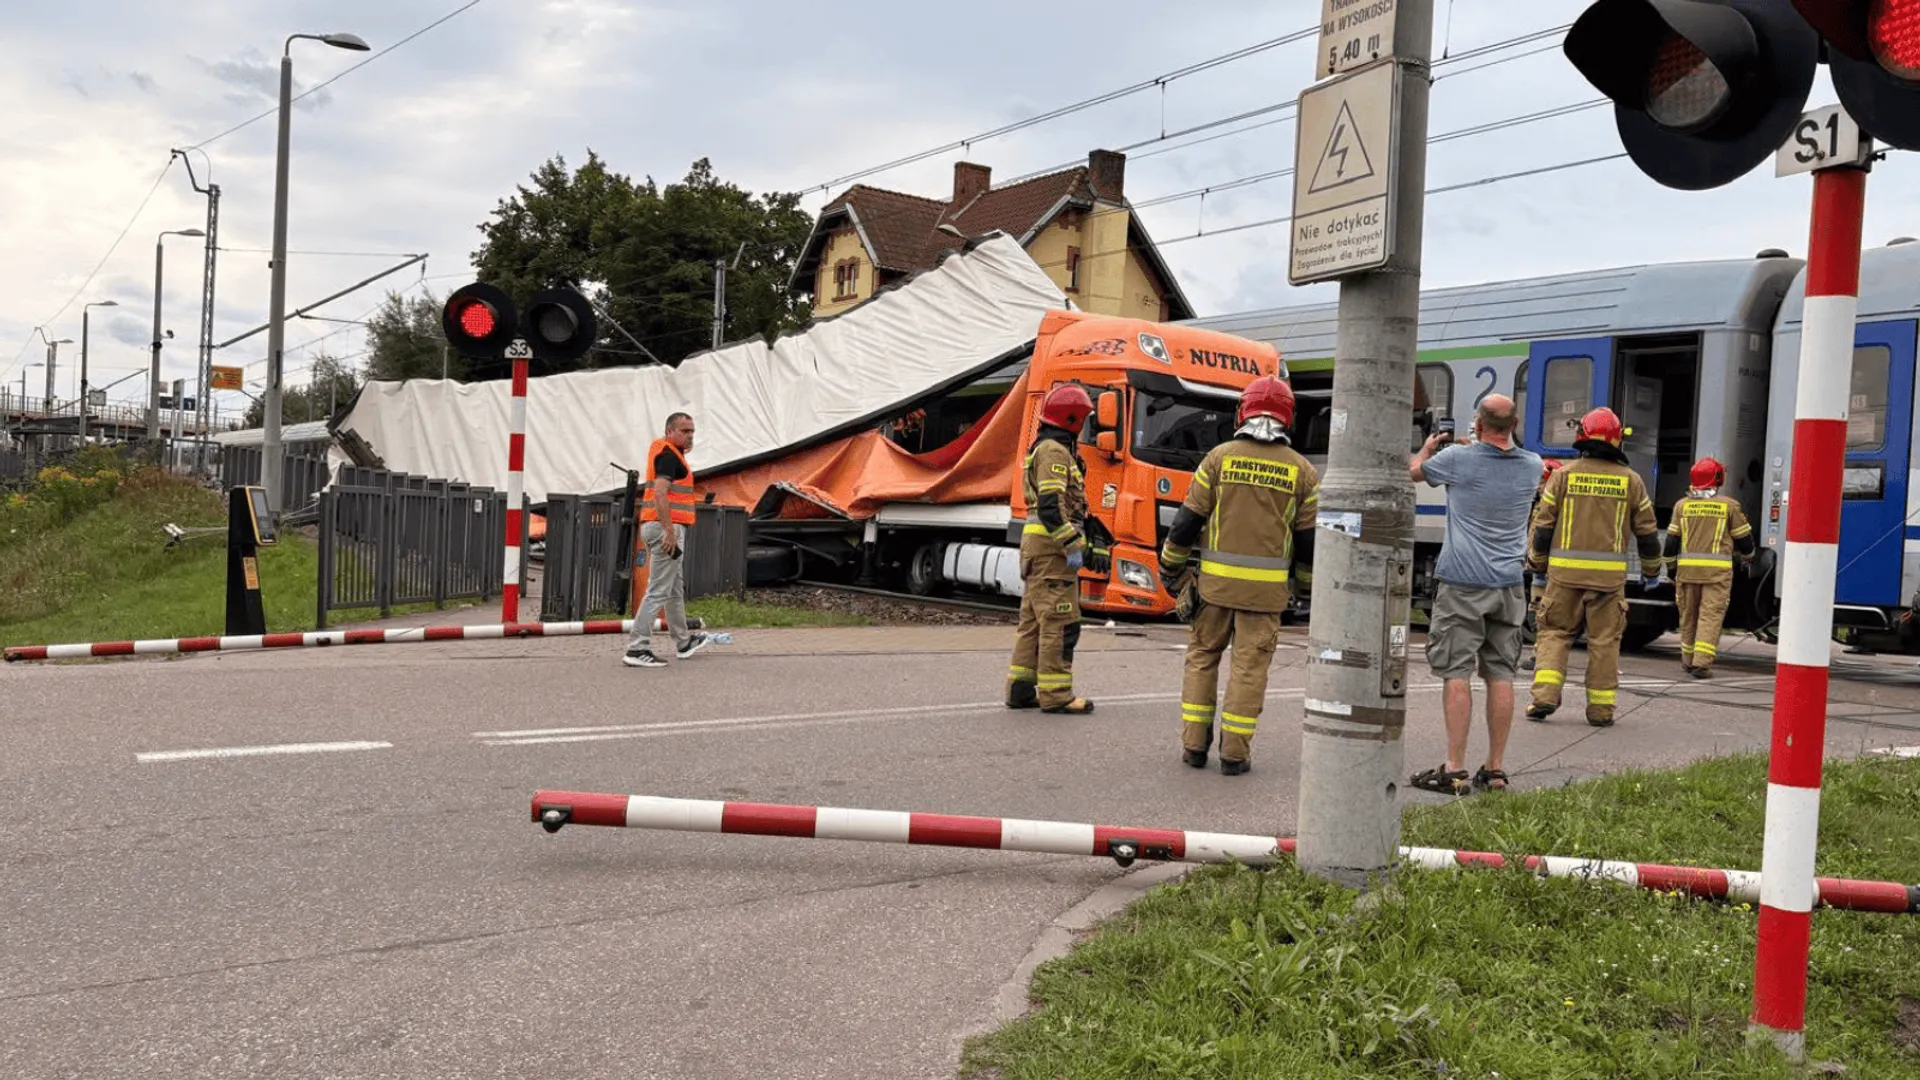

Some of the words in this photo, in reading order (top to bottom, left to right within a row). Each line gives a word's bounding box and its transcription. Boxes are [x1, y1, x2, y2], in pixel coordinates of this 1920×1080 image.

[1323, 21, 1335, 38] NA
[1367, 34, 1380, 53] m
[1299, 223, 1320, 242] Nie
[1340, 250, 1352, 261] dla
[1189, 348, 1261, 376] NUTRIA
[1473, 365, 1497, 410] 2
